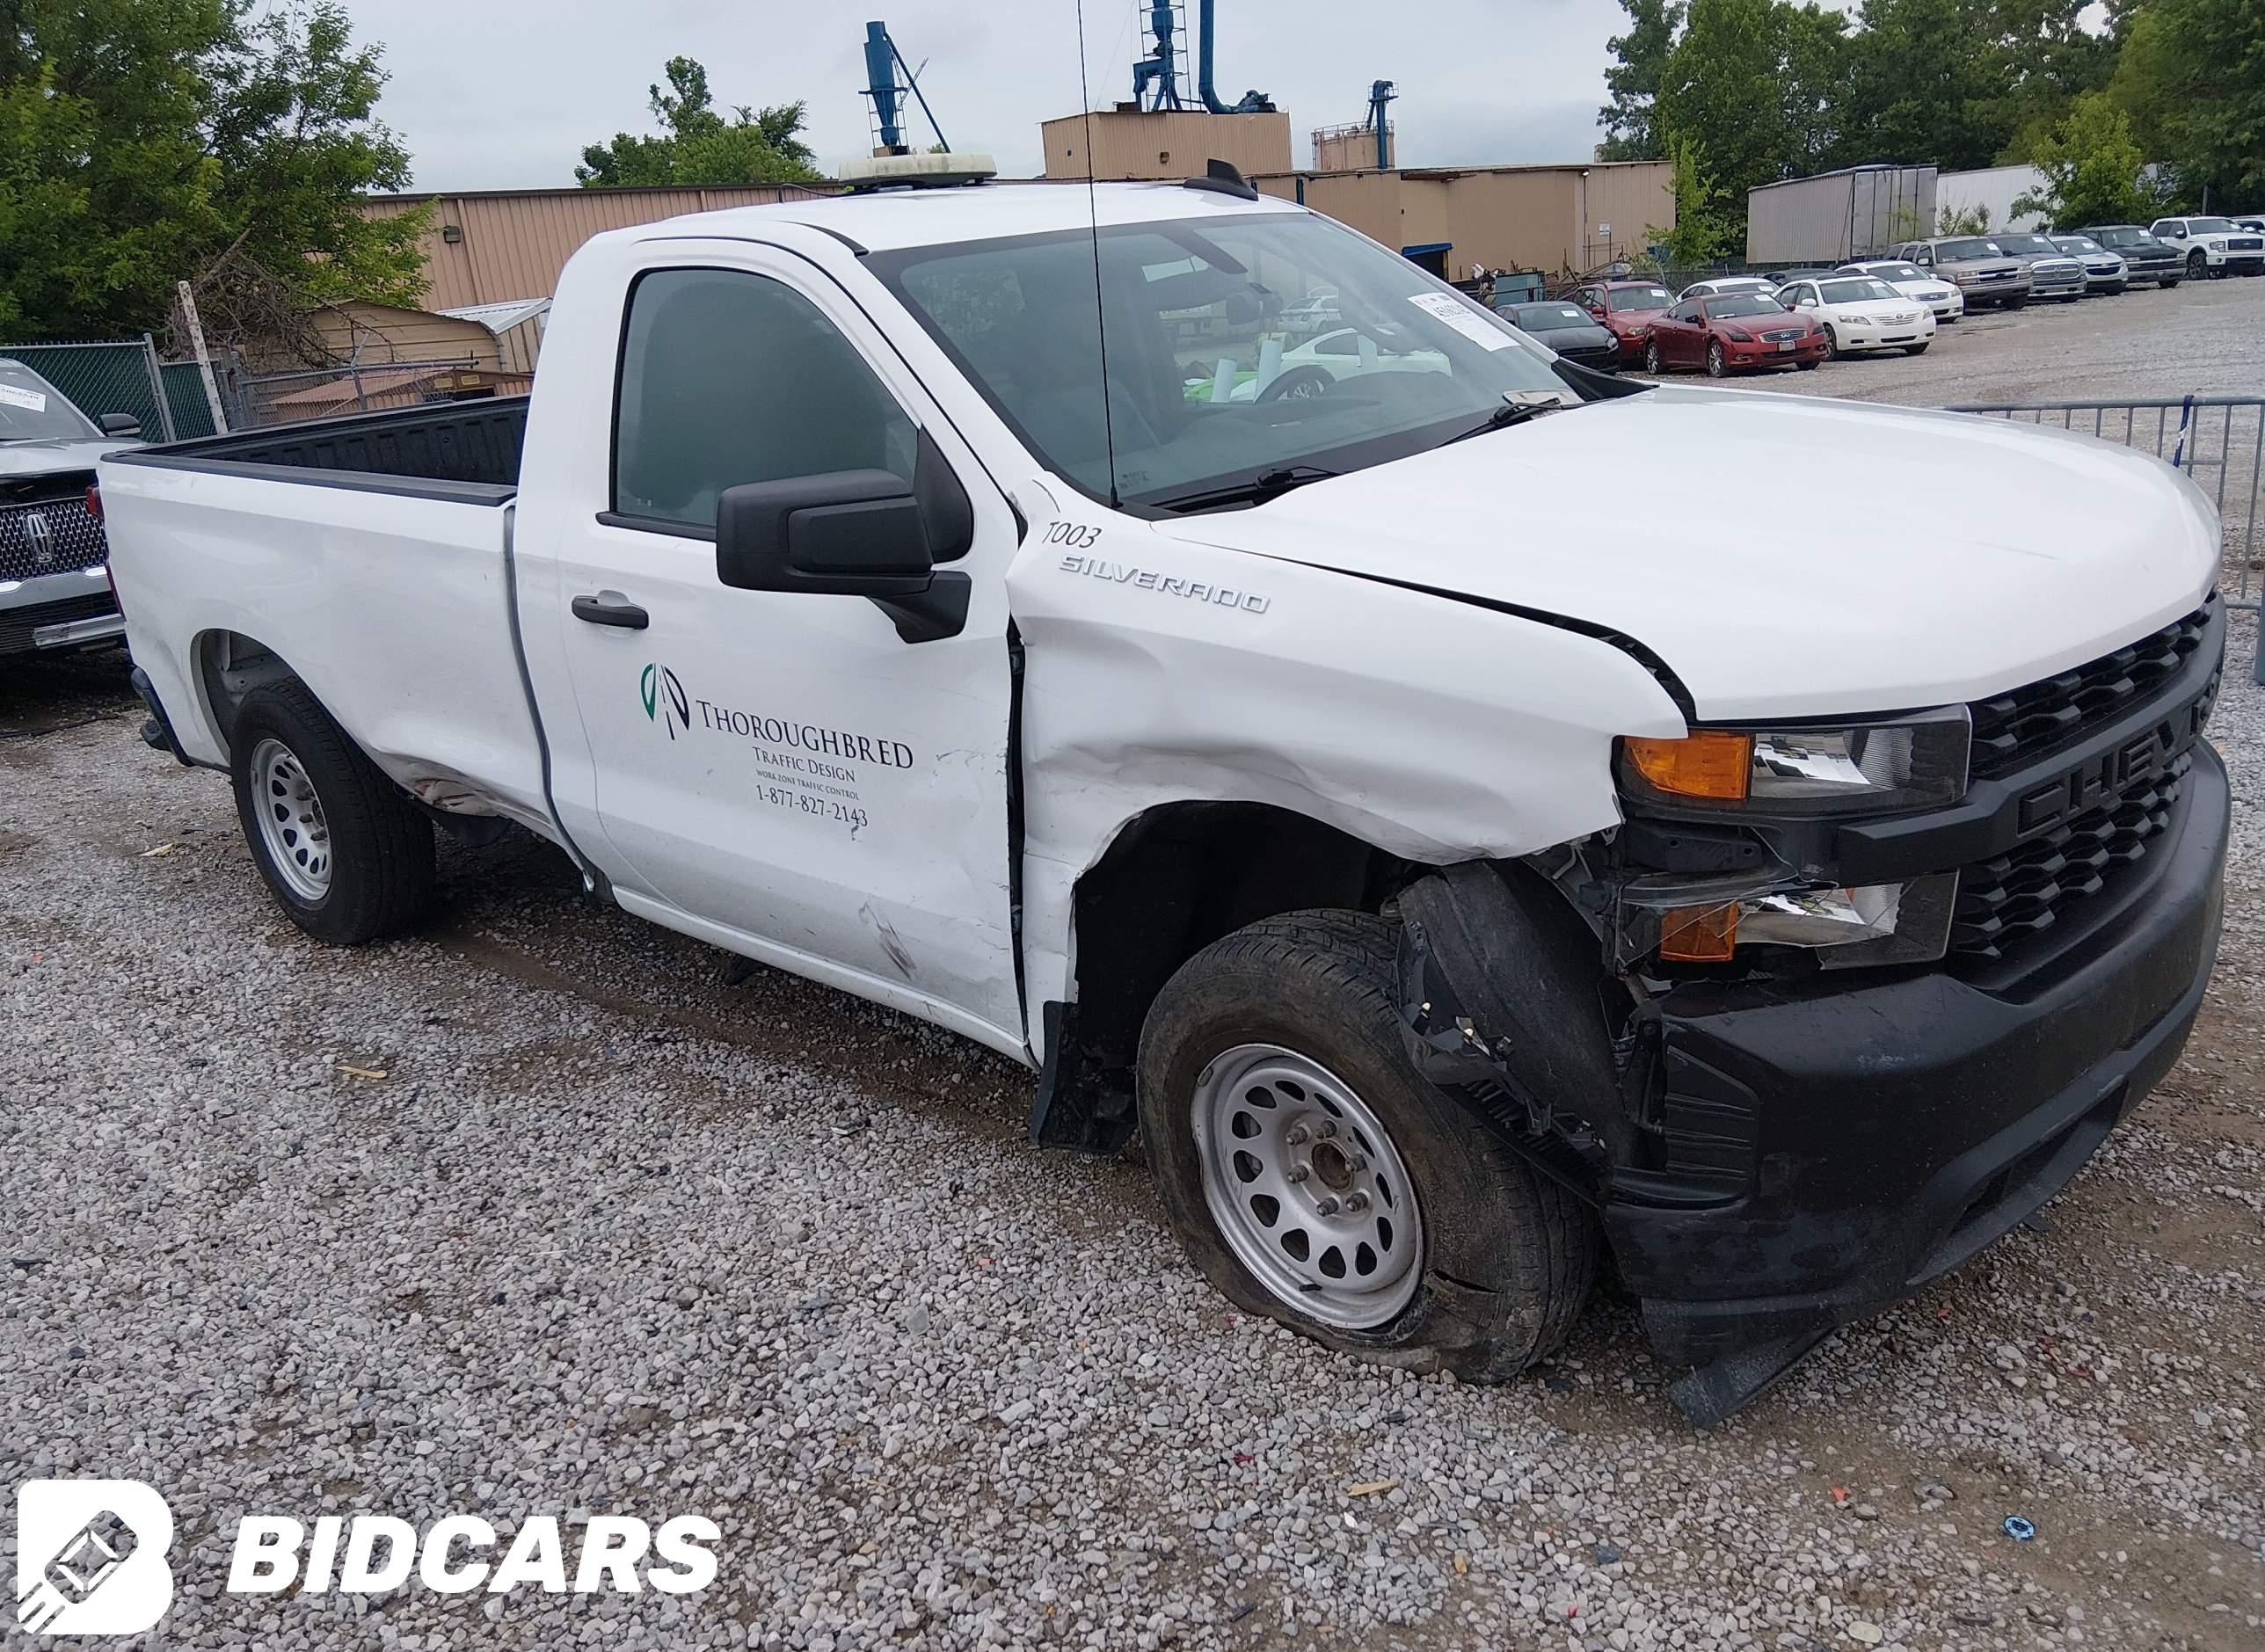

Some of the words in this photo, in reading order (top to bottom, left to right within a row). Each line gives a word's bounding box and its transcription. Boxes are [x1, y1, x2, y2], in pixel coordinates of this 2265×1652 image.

[1059, 555, 1271, 614] SILVERADO
[696, 700, 914, 769] THOROUGHBRED
[753, 746, 805, 772] TRAFFIC
[808, 759, 856, 782] DESIGN
[756, 769, 777, 781] WORK
[797, 779, 824, 792] TRAFFIC
[825, 786, 860, 801] CONTROL
[756, 784, 869, 827] 1-877-827-2143
